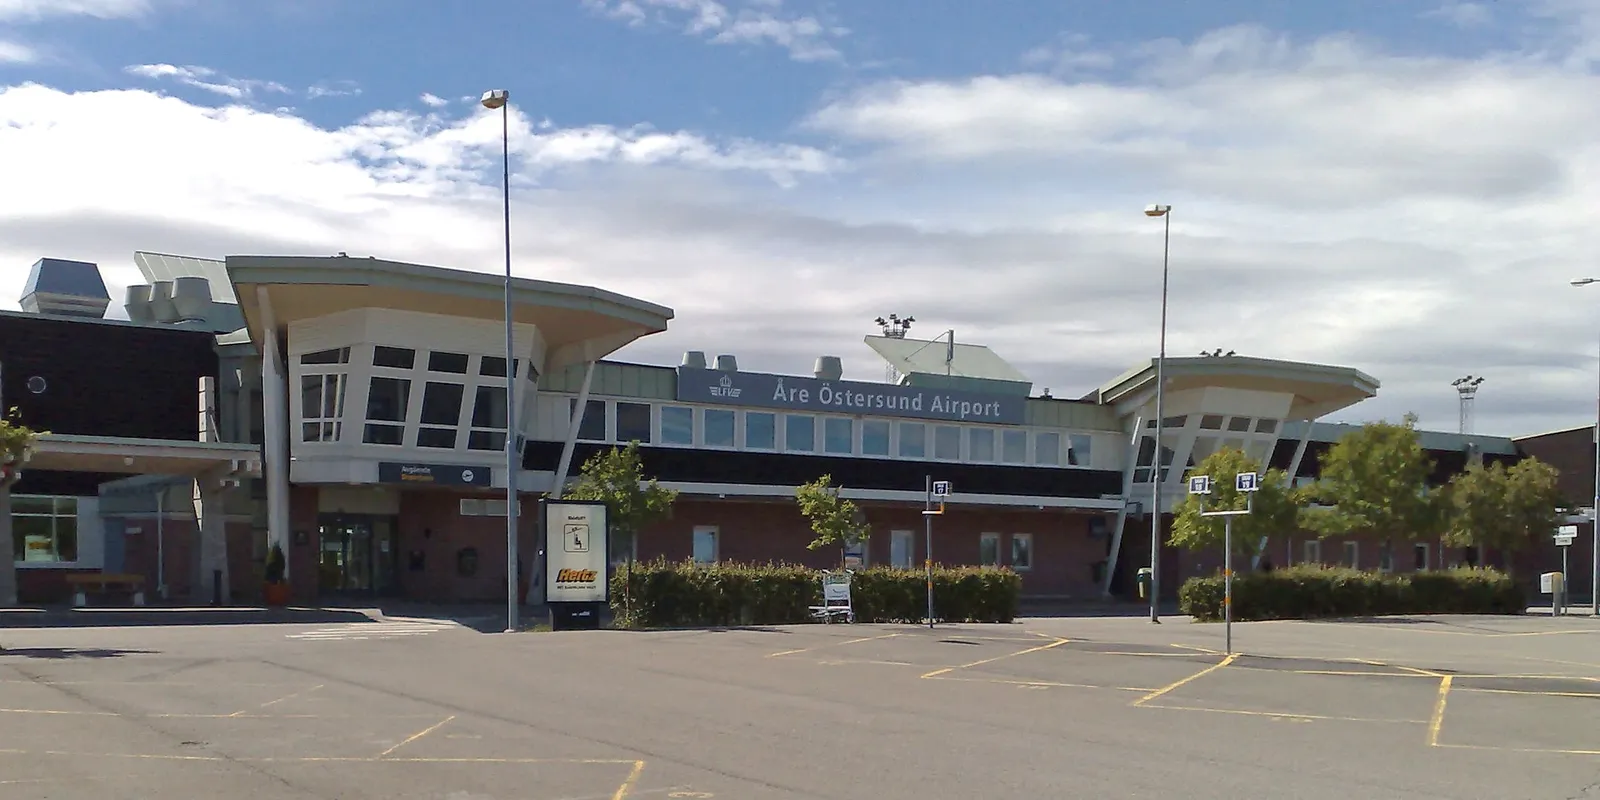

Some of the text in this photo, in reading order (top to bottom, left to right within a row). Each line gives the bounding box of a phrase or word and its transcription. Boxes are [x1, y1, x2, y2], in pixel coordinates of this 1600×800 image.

[773, 378, 1000, 419] Åre Östersund Airport
[556, 568, 598, 583] Hertz
